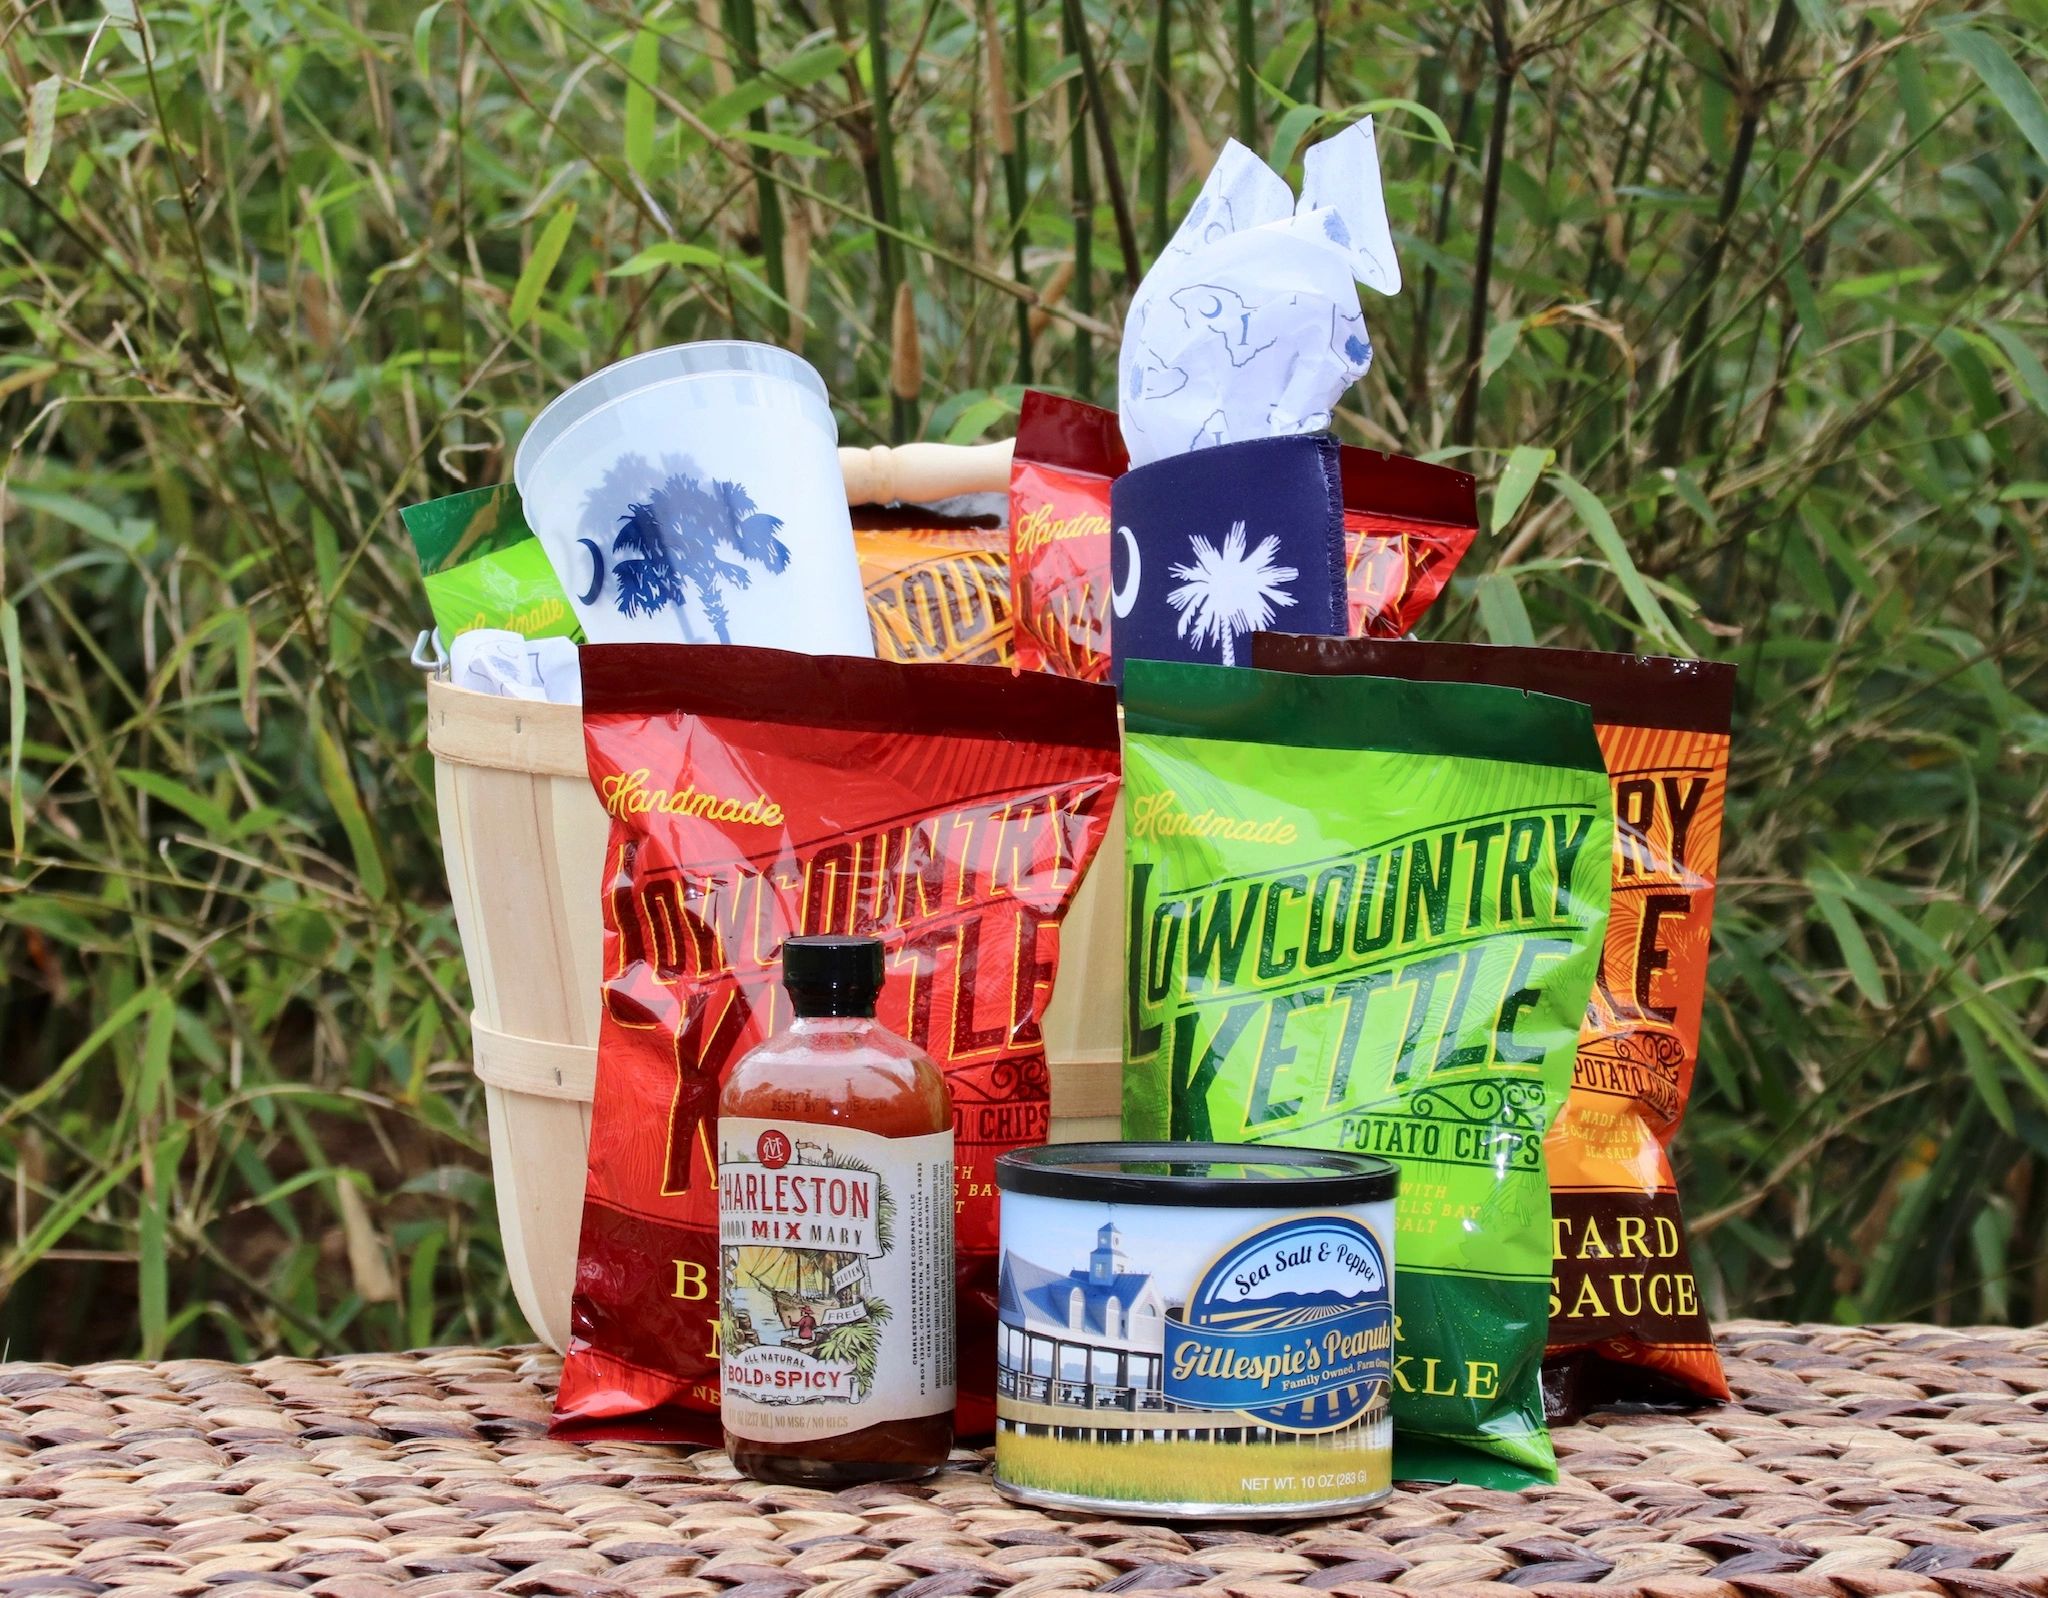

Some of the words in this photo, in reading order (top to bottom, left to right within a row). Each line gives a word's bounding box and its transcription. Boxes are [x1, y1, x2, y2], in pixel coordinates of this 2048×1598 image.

[601, 768, 785, 828] Handmade
[1133, 789, 1298, 845] Handmade
[1127, 813, 1597, 1066] LOWCOUNTRY
[1169, 938, 1574, 1143] KETTLE
[1574, 1057, 1645, 1094] POTATO
[979, 1103, 1050, 1139] CHIPS
[1337, 1118, 1440, 1156] POTATO
[1453, 1127, 1541, 1165] CHIPS
[967, 1183, 1001, 1197] BA
[1400, 1182, 1448, 1200] WITH
[1400, 1199, 1433, 1216] LLS
[1441, 1203, 1482, 1220] BAY
[752, 1220, 802, 1241] MIX
[810, 1224, 863, 1246] MARY
[1552, 1216, 1680, 1260] TARD
[836, 1265, 861, 1287] GLUTEN
[1234, 1262, 1272, 1296] Sea
[1274, 1245, 1313, 1272] Salt
[1317, 1241, 1332, 1262] &
[1336, 1243, 1375, 1283] Pepper
[828, 1309, 861, 1321] FREE
[744, 1355, 759, 1364] ALL
[761, 1352, 806, 1368] NATURAL
[1171, 1339, 1321, 1389] Gillespie's
[1322, 1321, 1390, 1366] Peanuts
[728, 1365, 764, 1386] BOLD
[774, 1370, 841, 1389] SPICY
[1282, 1374, 1321, 1392] Family
[1321, 1363, 1356, 1381] Owned,
[1356, 1359, 1375, 1372] Farm
[1241, 1477, 1270, 1491] NET
[1273, 1476, 1297, 1490] WT.
[1301, 1476, 1316, 1489] 10
[1317, 1474, 1335, 1488] OZ
[1336, 1471, 1357, 1488] (283
